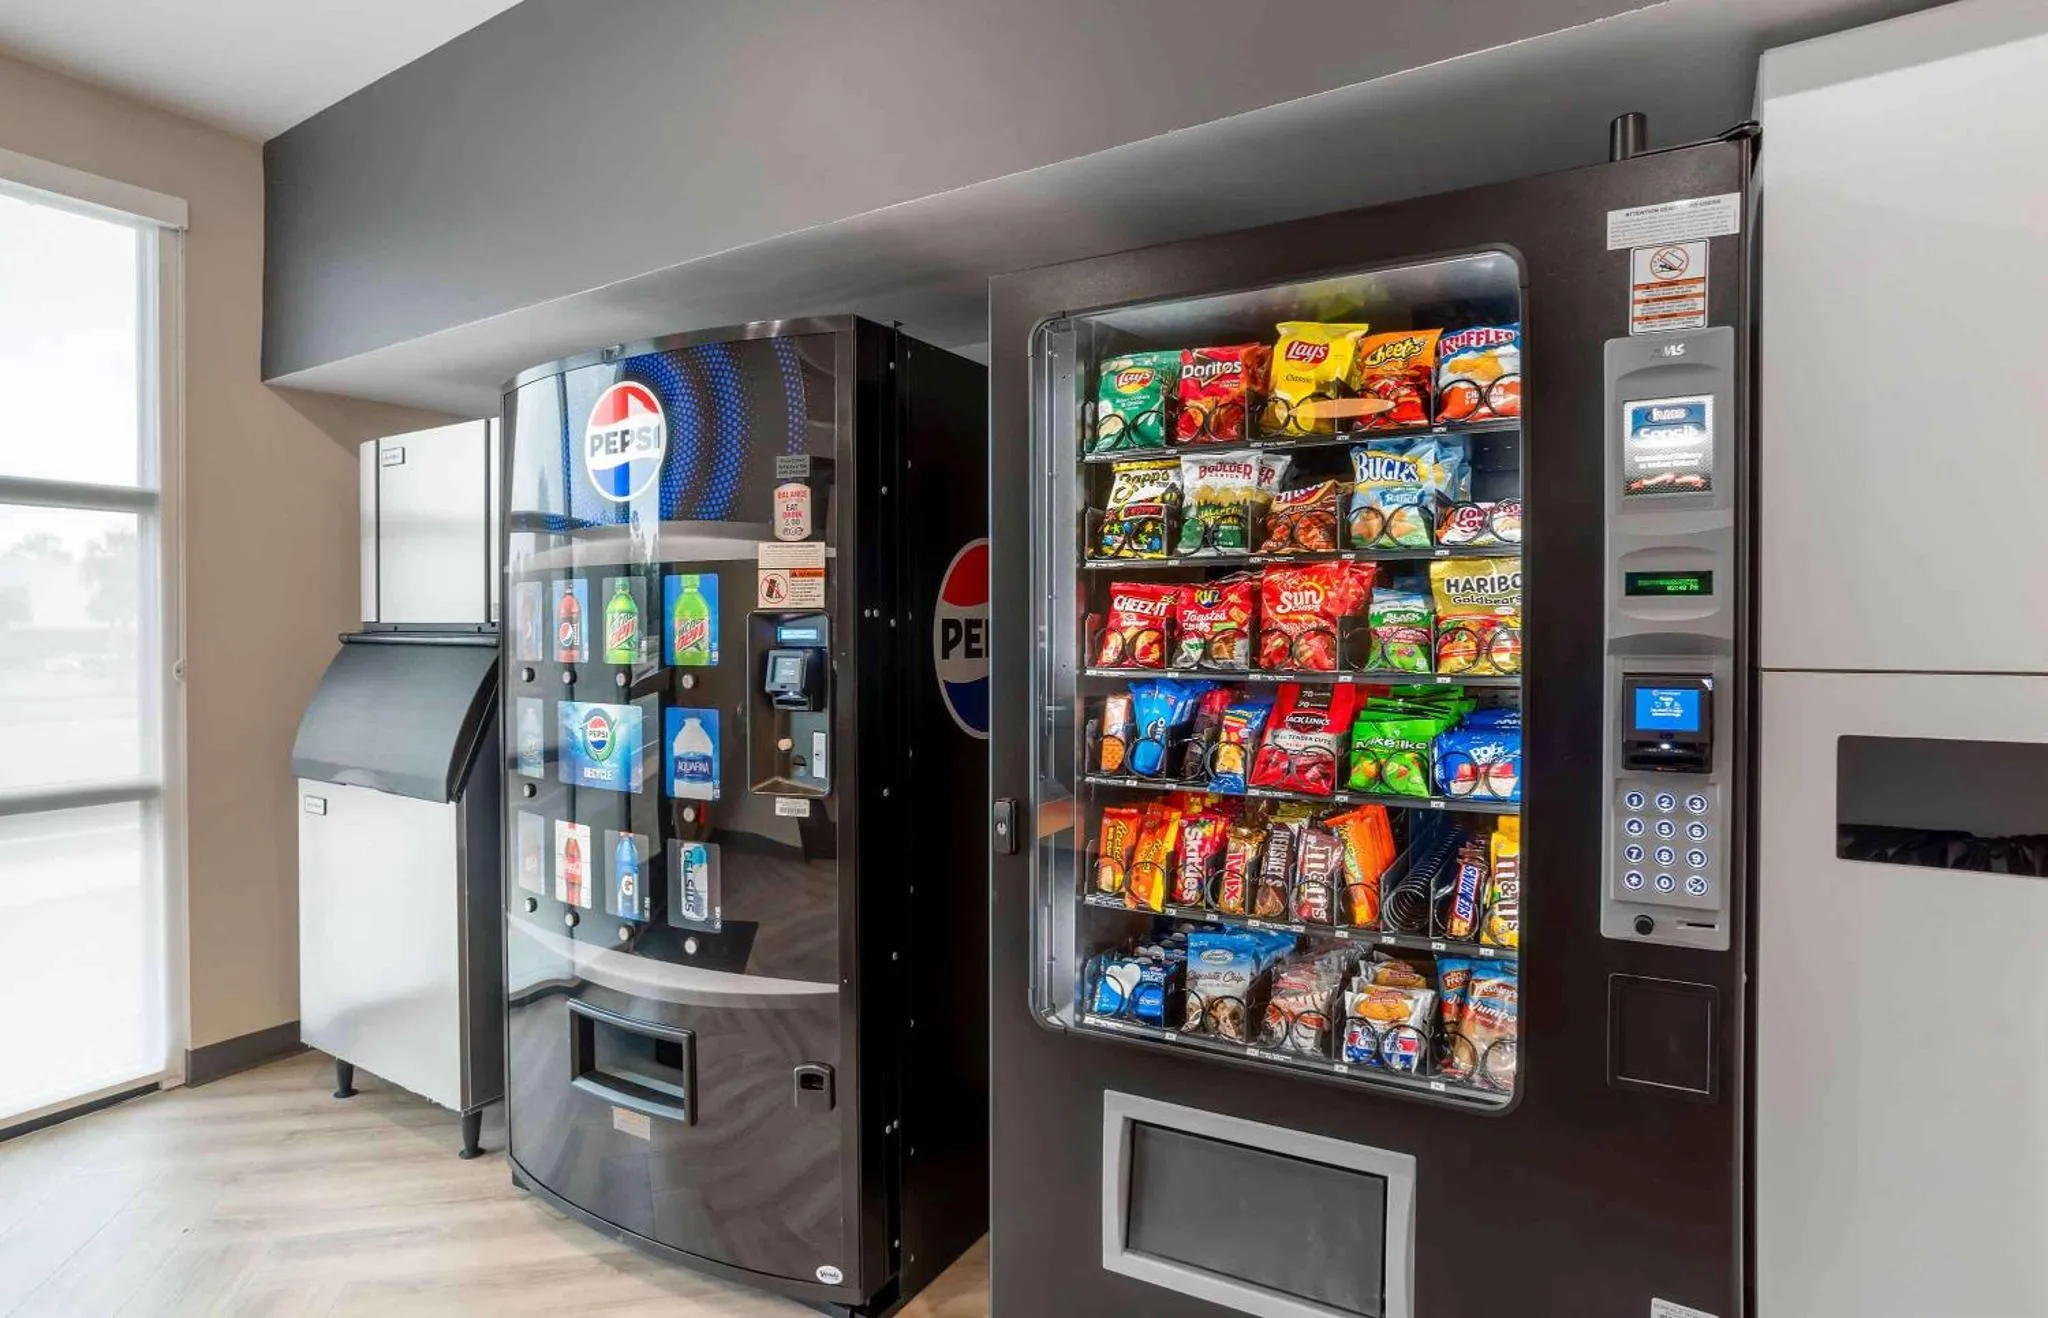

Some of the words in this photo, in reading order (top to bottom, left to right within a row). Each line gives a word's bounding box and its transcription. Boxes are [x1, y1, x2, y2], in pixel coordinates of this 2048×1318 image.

[1286, 341, 1328, 364] Lay's
[1440, 329, 1515, 357] RUFFLES
[1118, 370, 1153, 387] Lay's
[1182, 361, 1242, 379] Doritos
[590, 423, 661, 459] PEPSI
[1199, 461, 1253, 480] BOULDER
[1355, 451, 1420, 484] BUGLES
[1113, 594, 1169, 616] CHEEZ-IT
[1276, 590, 1318, 614] Sun
[1183, 609, 1228, 621] Toasted
[1661, 797, 1671, 808] 2
[1692, 799, 1701, 810] 3
[1630, 822, 1640, 833] 4
[1661, 824, 1670, 834] 5
[1692, 826, 1701, 837] 6
[1183, 827, 1203, 900] Skittles
[1265, 829, 1291, 888] HERSHEY'S
[1630, 848, 1639, 858] 7
[1660, 850, 1670, 861] 8
[1692, 853, 1701, 863] 9
[683, 850, 695, 913] CELSIUS
[1224, 853, 1246, 900] TWIX
[1660, 878, 1669, 888] 0
[1456, 863, 1478, 919] SNICKERS
[1222, 970, 1247, 984] Chip
